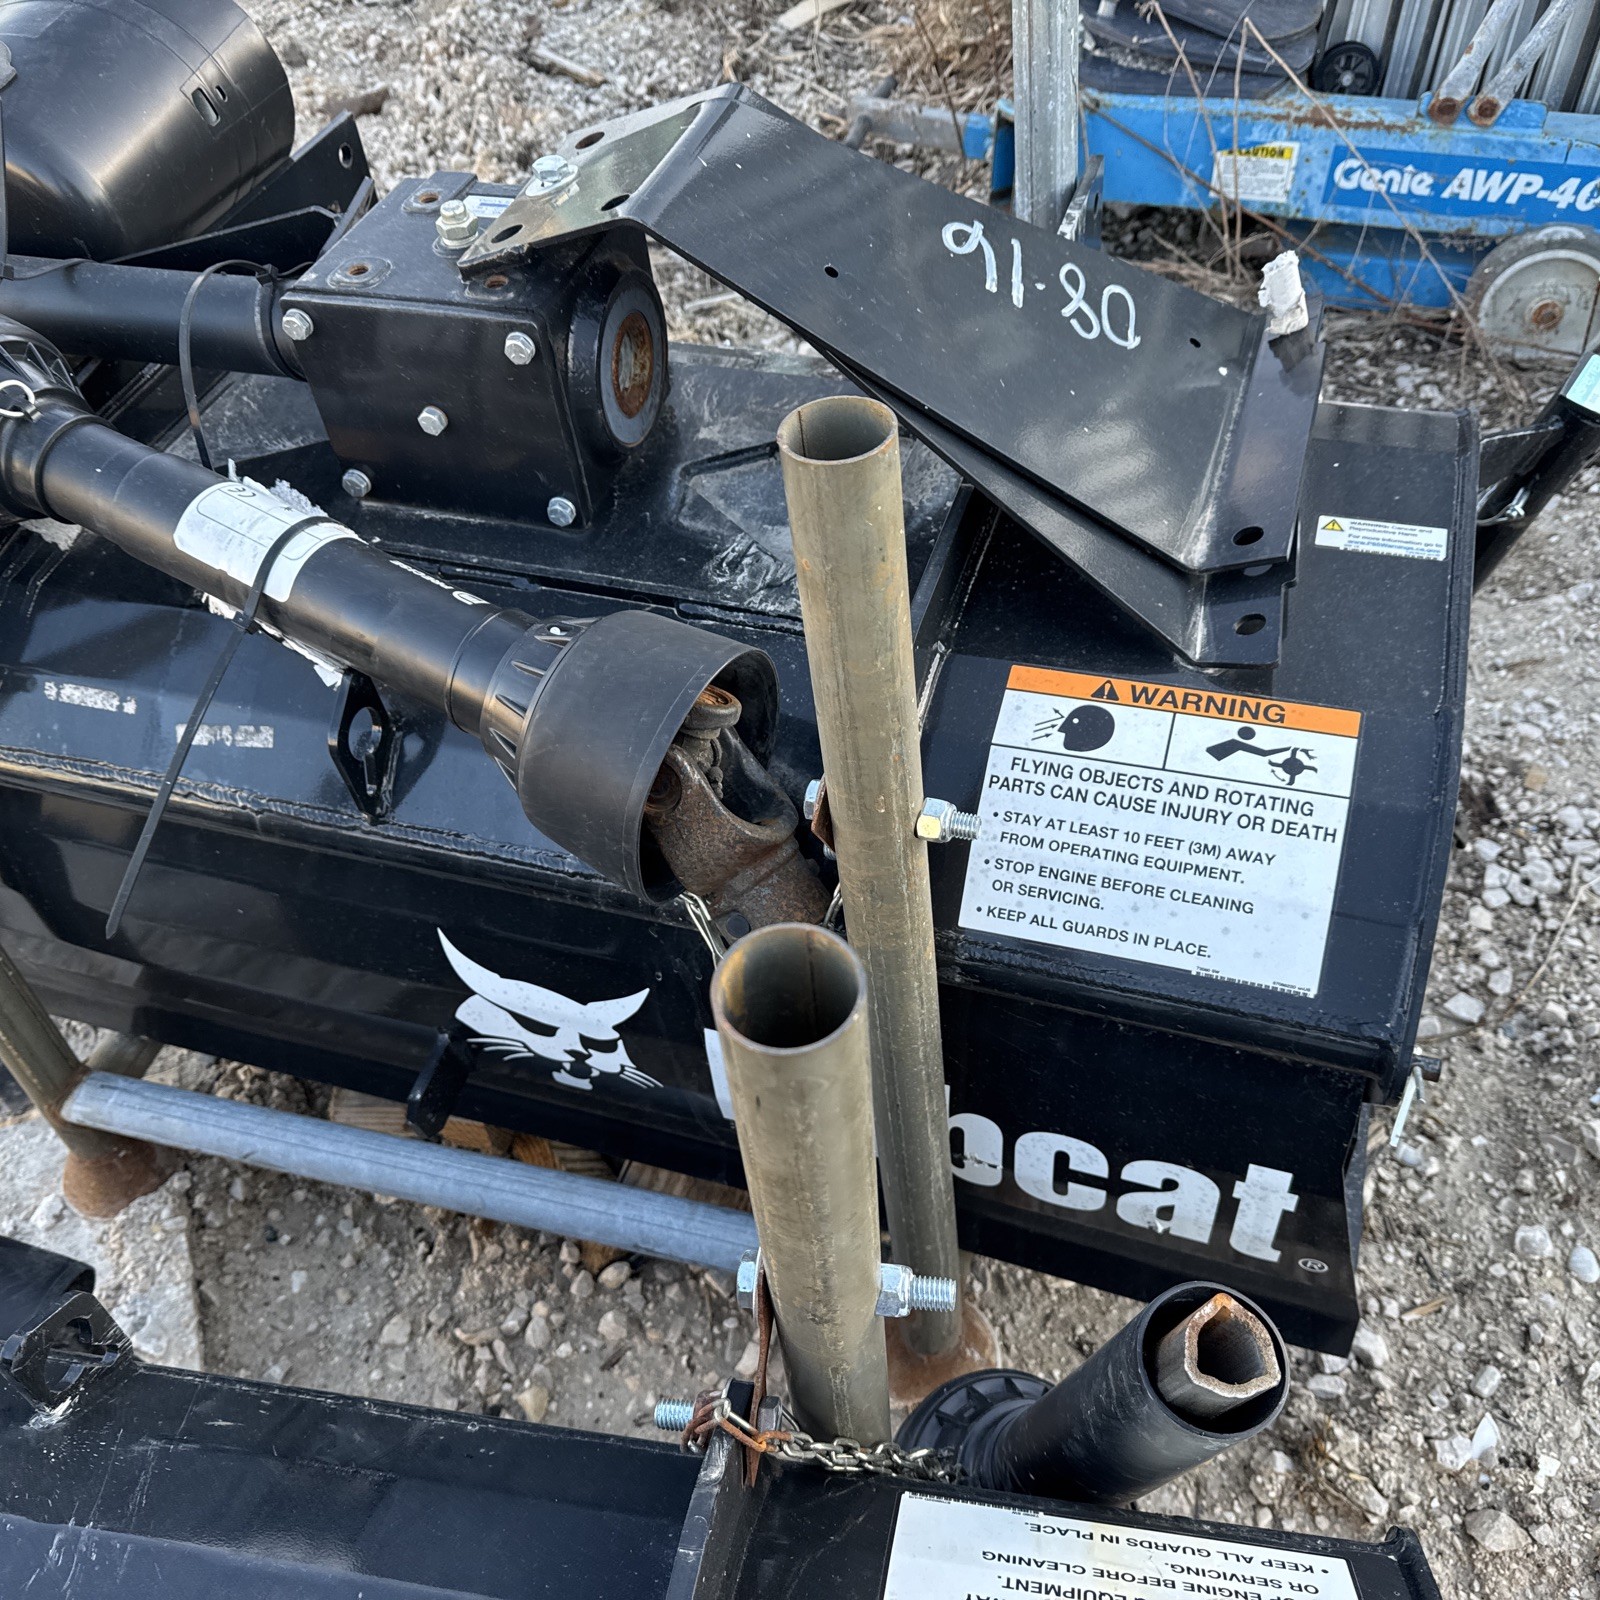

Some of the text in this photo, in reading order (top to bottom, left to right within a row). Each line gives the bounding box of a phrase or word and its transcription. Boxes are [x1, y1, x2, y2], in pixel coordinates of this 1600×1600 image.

[1333, 157, 1434, 197] Genie
[1130, 684, 1286, 724] WARNING
[988, 775, 1337, 843] PARTS CAN CAUSE INJURY OR DEATH
[1010, 757, 1315, 818] FLYING OBJECTS AND ROTATING
[1000, 832, 1245, 884] FROM OPERATING EQUIPMENT.
[1003, 811, 1276, 866] STAY AT LEAST 10 FEET (3M) AWAY
[992, 879, 1105, 910] OR SERVICING.
[994, 858, 1255, 914] STOP ENGINE BEFORE CLEANING
[986, 905, 1212, 958] KEEP ALL GUARDS IN PLACE.
[1025, 1522, 1315, 1573] KEEP ALL GUARDS IN PLACE.
[982, 1550, 1262, 1600] ENGINE BEFORE CLEANING
[1165, 1562, 1319, 1594] OR SERVICING.
